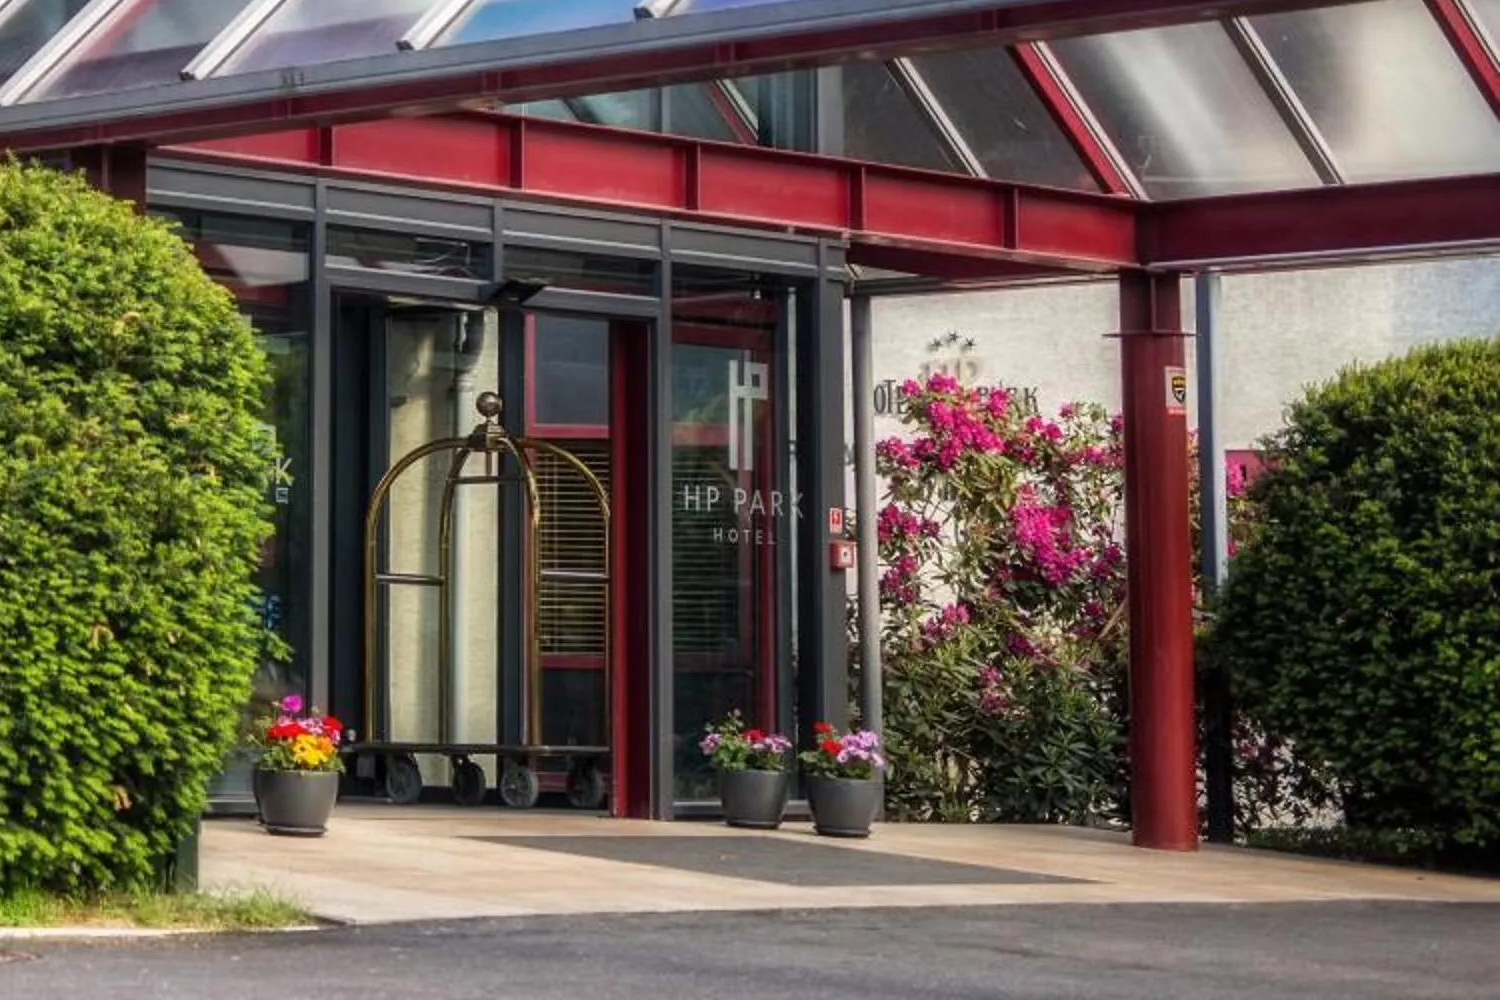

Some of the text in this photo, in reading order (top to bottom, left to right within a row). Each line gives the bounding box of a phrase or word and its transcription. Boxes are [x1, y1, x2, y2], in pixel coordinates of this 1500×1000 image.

[683, 484, 804, 519] HP PARK
[713, 527, 776, 545] HOTEL
